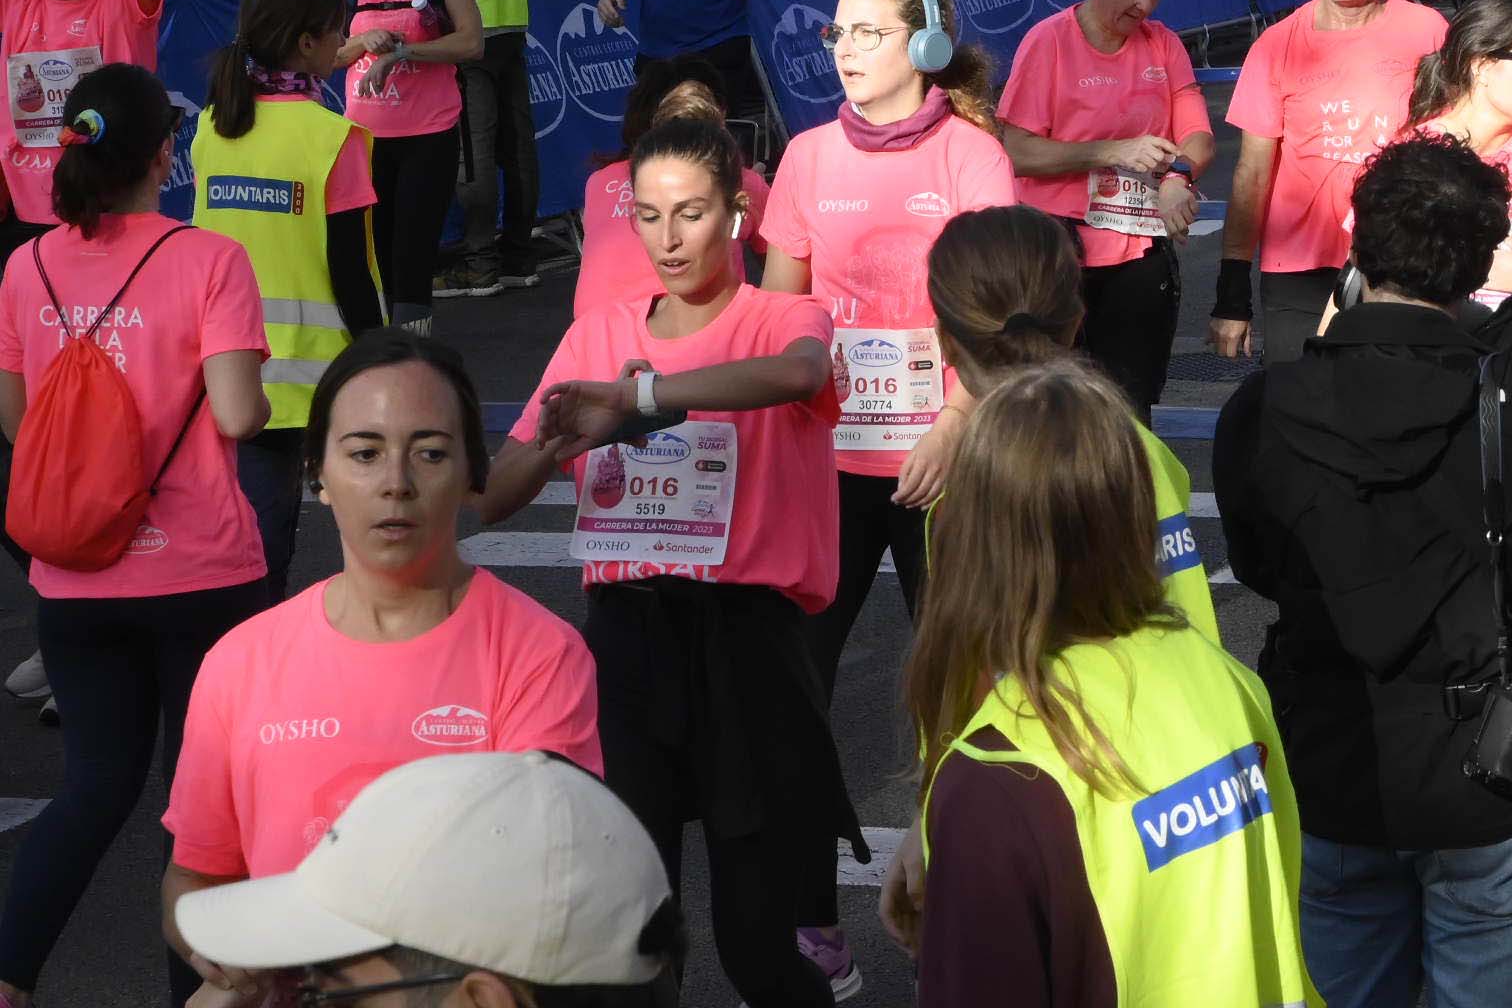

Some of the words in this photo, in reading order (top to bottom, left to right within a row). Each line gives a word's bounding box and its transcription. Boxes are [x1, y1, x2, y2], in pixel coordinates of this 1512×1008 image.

[1320, 99, 1352, 114] WE
[1376, 132, 1386, 146] A
[1122, 179, 1147, 195] 016
[817, 198, 869, 214] OYSHO
[39, 305, 145, 329] CARRERA
[852, 349, 899, 361] ASTURIANA
[907, 345, 932, 353] SUMA
[854, 377, 898, 394] 016
[858, 399, 893, 410] 30774
[630, 445, 686, 458] ASTURIANA
[696, 442, 728, 451] SUMA
[629, 476, 680, 497] 016
[635, 502, 666, 516] 5519
[593, 521, 632, 530] CARRERA
[632, 522, 646, 530] DE
[647, 523, 657, 531] LA
[657, 524, 690, 532] MUJER
[691, 525, 714, 534] 2023
[585, 539, 631, 552] OYSHO
[664, 541, 715, 554] Santander
[259, 716, 341, 747] OYSHO
[417, 718, 487, 738] ASTURIANA
